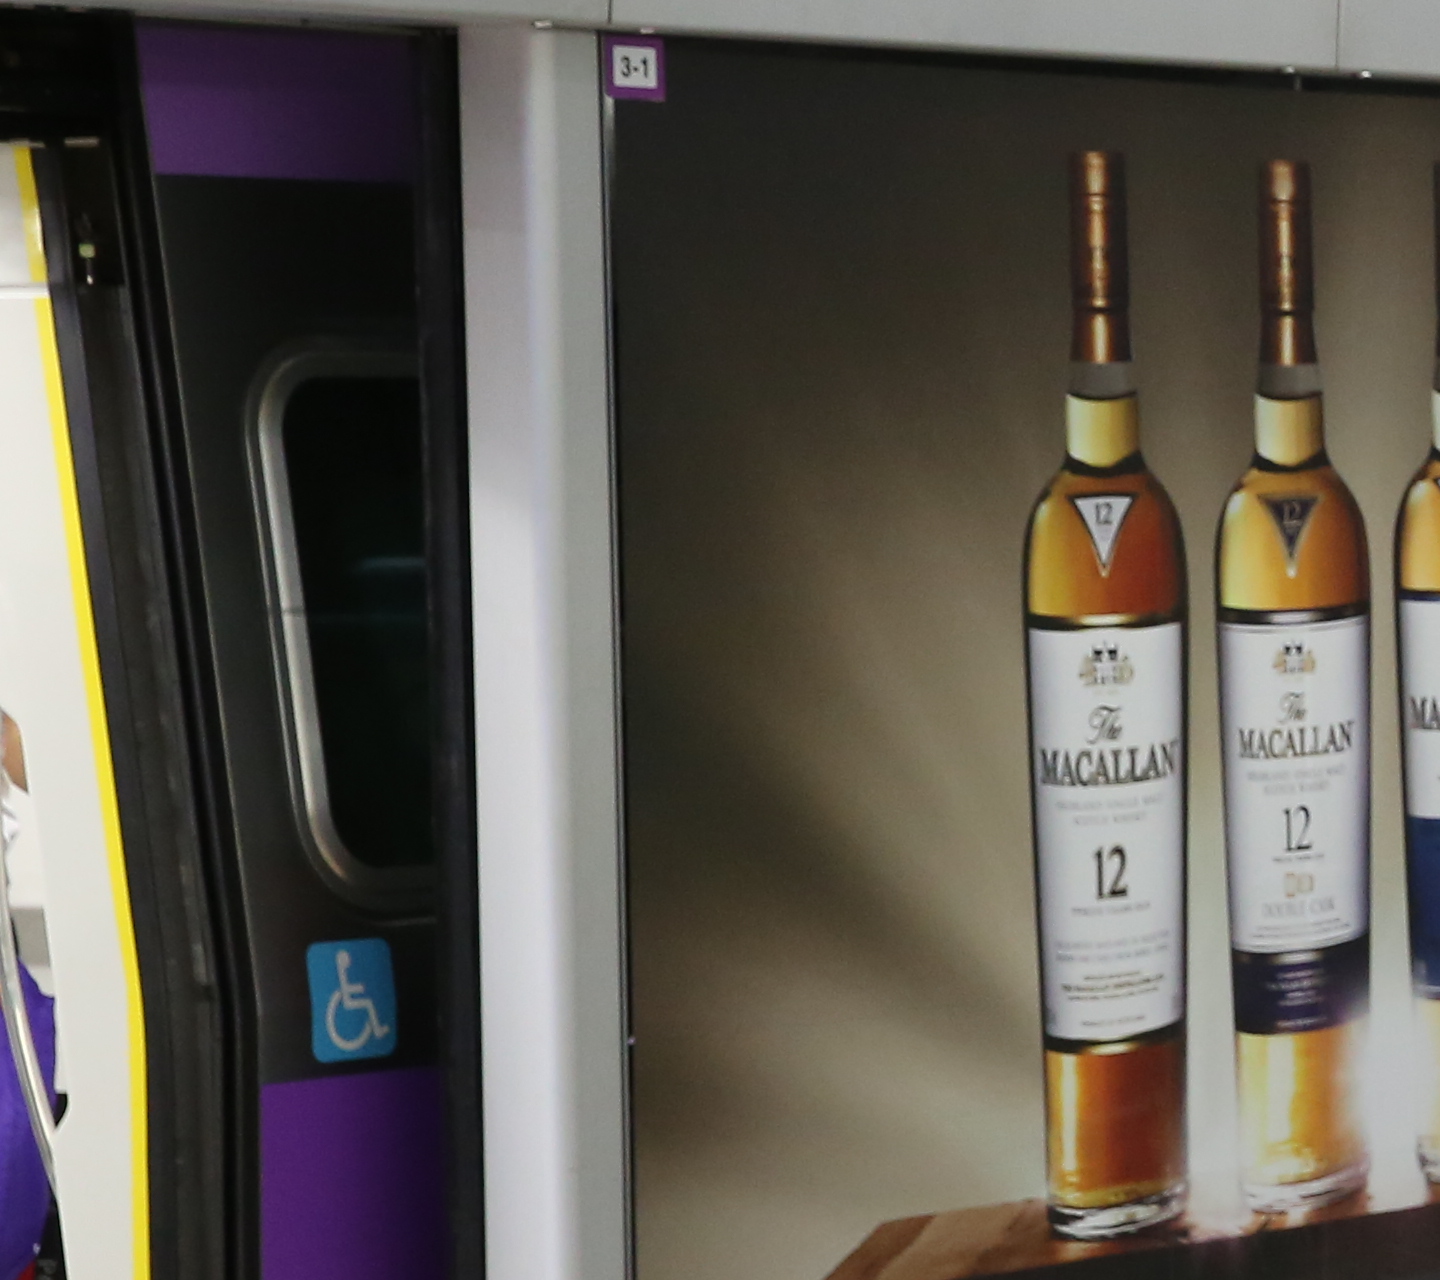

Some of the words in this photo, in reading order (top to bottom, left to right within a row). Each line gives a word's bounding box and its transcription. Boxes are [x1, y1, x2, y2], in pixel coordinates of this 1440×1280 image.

[619, 56, 651, 81] 3-1
[1238, 719, 1354, 760] MACALLAN
[1039, 741, 1177, 789] MACALLAN
[1282, 803, 1313, 852] 12
[1093, 842, 1129, 901] 12
